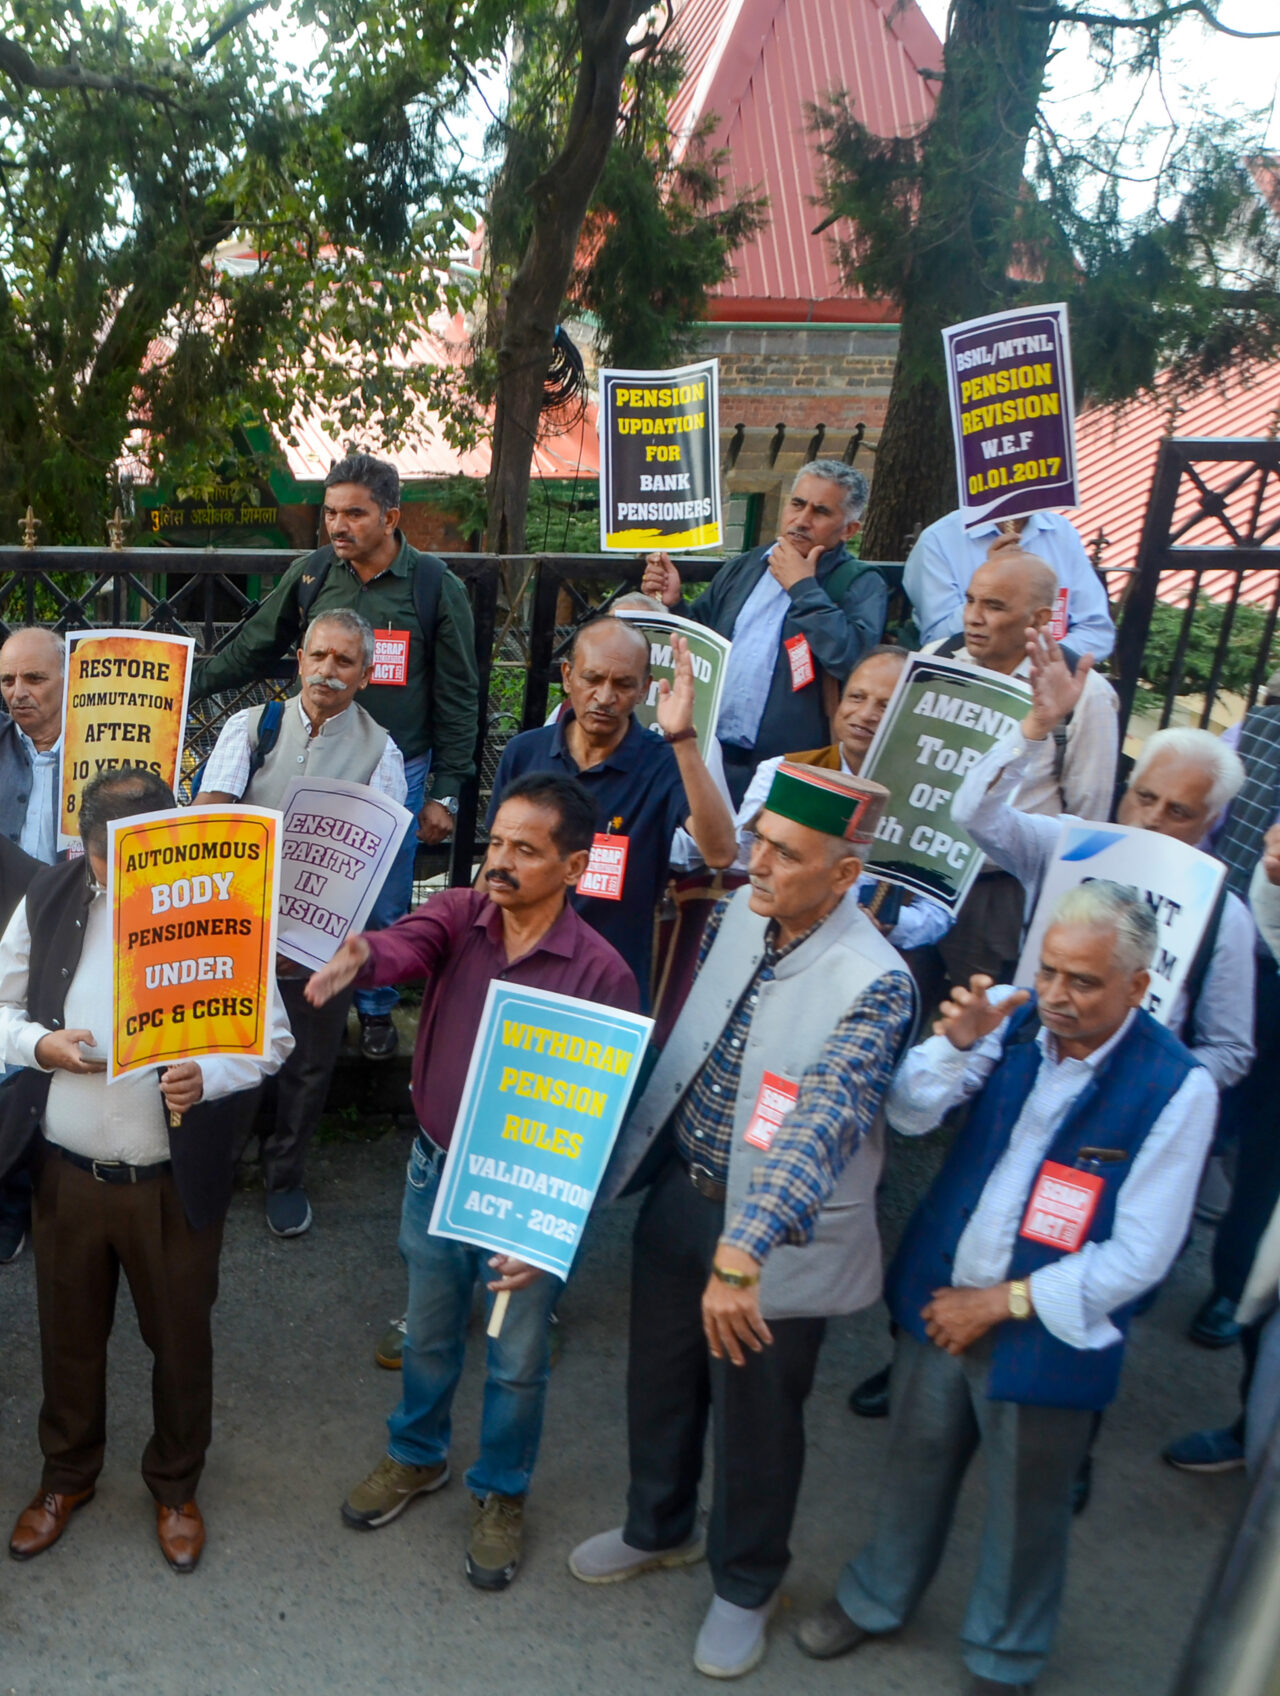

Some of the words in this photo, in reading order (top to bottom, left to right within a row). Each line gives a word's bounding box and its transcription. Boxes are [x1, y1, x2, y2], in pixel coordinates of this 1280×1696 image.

[956, 333, 1053, 372] BSNL/MTNL
[616, 383, 705, 408] PENSION
[961, 363, 1052, 405] PENSION
[618, 412, 705, 436] UPDATION
[961, 393, 1060, 436] REVISION
[646, 445, 681, 462] FOR
[981, 431, 1034, 460] W.E.F
[640, 474, 691, 492] BANK
[968, 457, 1061, 495] 01.01.2017
[151, 503, 184, 531] पुलिस
[618, 498, 711, 522] PENSIONERS
[375, 642, 403, 655] SCRAP
[79, 658, 170, 682] RESTORE
[375, 664, 395, 679] ACT
[72, 691, 173, 711] COMMUTATION
[913, 691, 1020, 740] AMEND
[85, 722, 151, 743] AFTER
[73, 760, 89, 780] 10
[67, 794, 75, 813] 8
[908, 782, 953, 812] OF
[285, 813, 382, 857] ENSURE
[873, 816, 904, 845] th
[909, 825, 971, 869] CPC
[126, 841, 260, 872] AUTONOMOUS
[282, 840, 366, 880] PARITY
[151, 871, 234, 915] BODY
[295, 870, 328, 897] IN
[583, 872, 609, 891] ACT
[279, 894, 348, 938] NSION
[128, 918, 252, 950] PENSIONERS
[145, 956, 234, 989] UNDER
[126, 1008, 164, 1036] CPC
[172, 1004, 185, 1023] &
[193, 997, 253, 1020] CGHS
[502, 1020, 633, 1077] WITHDRAW
[499, 1067, 608, 1118] PENSION
[501, 1114, 584, 1159] RULES
[469, 1154, 593, 1211] VALIDATION
[464, 1190, 513, 1219] ACT
[527, 1208, 577, 1244] 2025
